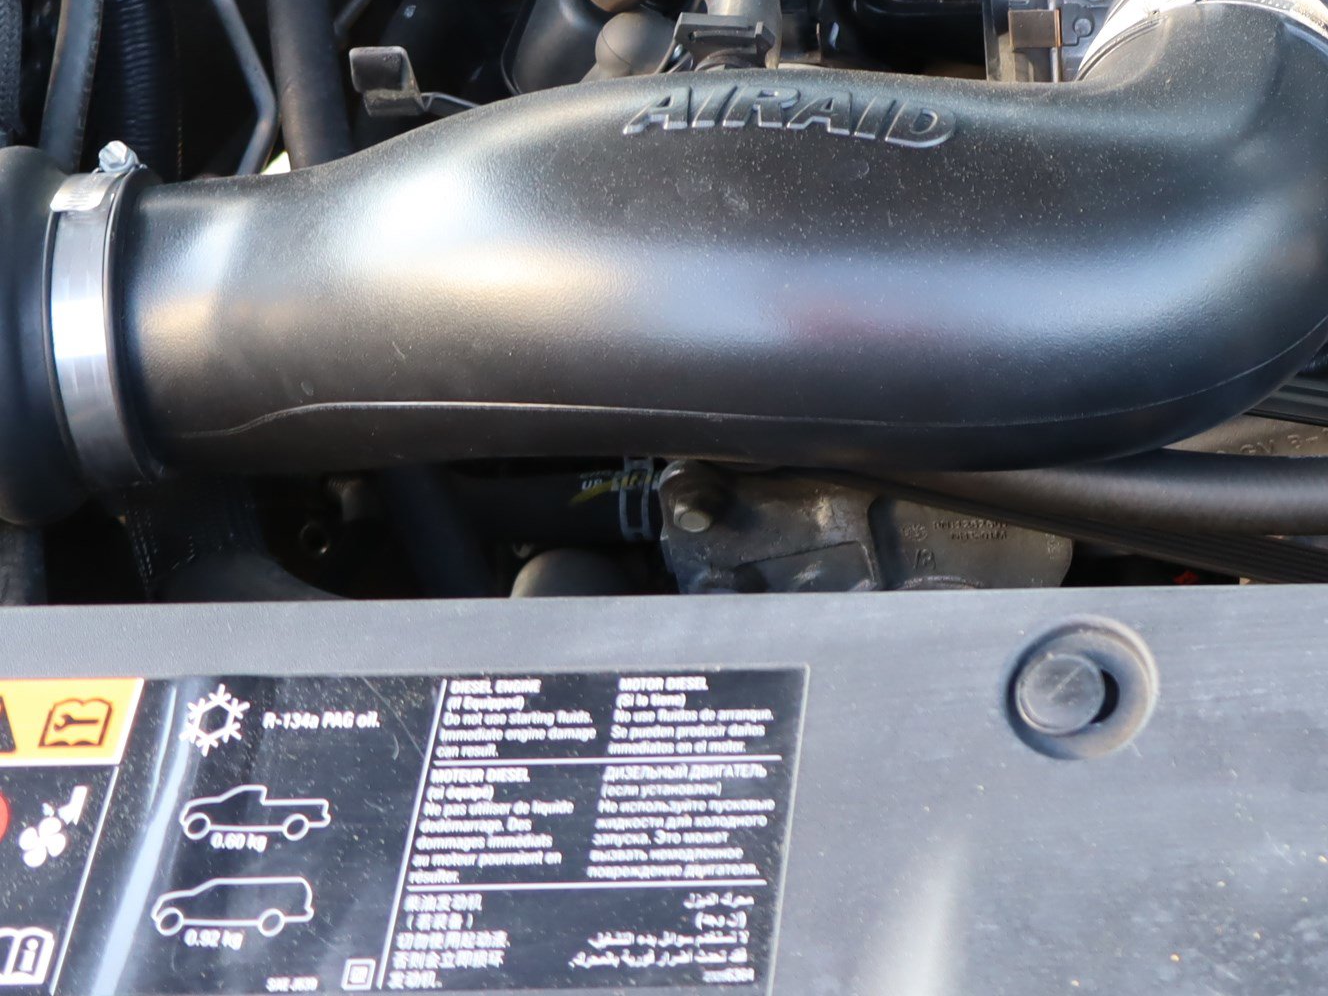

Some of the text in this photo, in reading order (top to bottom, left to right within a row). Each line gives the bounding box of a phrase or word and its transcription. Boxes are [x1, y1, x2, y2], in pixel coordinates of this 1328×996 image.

[622, 84, 958, 149] AIRAID
[262, 711, 320, 730] R-134a
[322, 711, 354, 728] PAG
